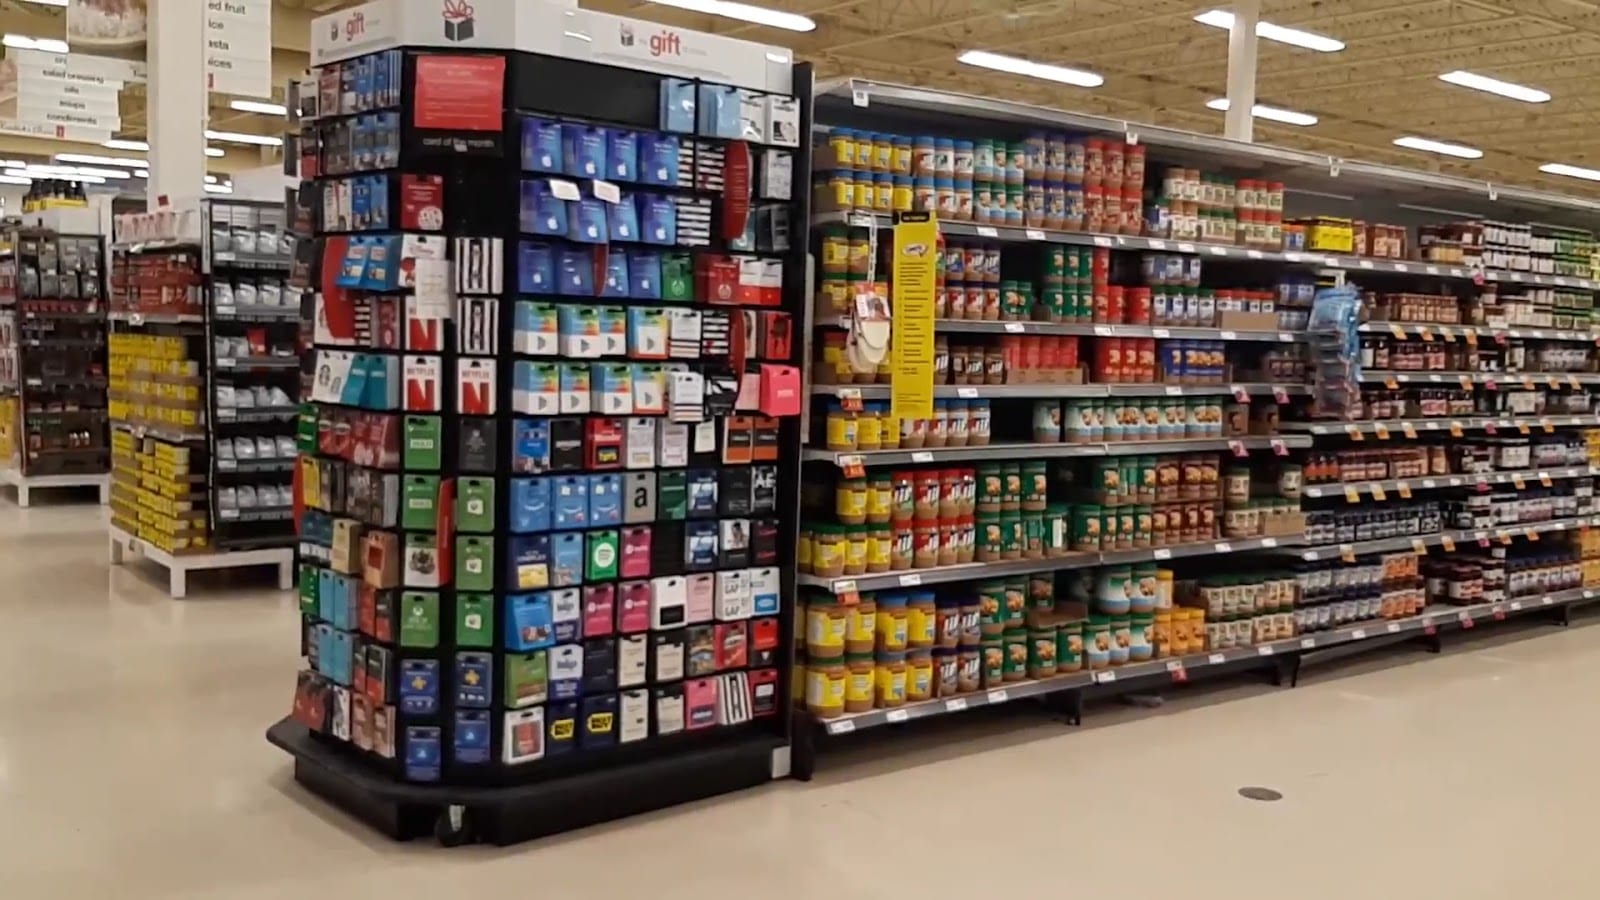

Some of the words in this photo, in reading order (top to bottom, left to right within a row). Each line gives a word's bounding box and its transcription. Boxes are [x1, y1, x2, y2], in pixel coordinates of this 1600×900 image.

[225, 2, 246, 15] fruit
[346, 11, 365, 42] gift
[649, 29, 681, 57] gift
[46, 113, 98, 125] condiments
[422, 137, 442, 146] card
[443, 137, 453, 146] of
[755, 472, 776, 488] AE
[634, 486, 648, 509] a
